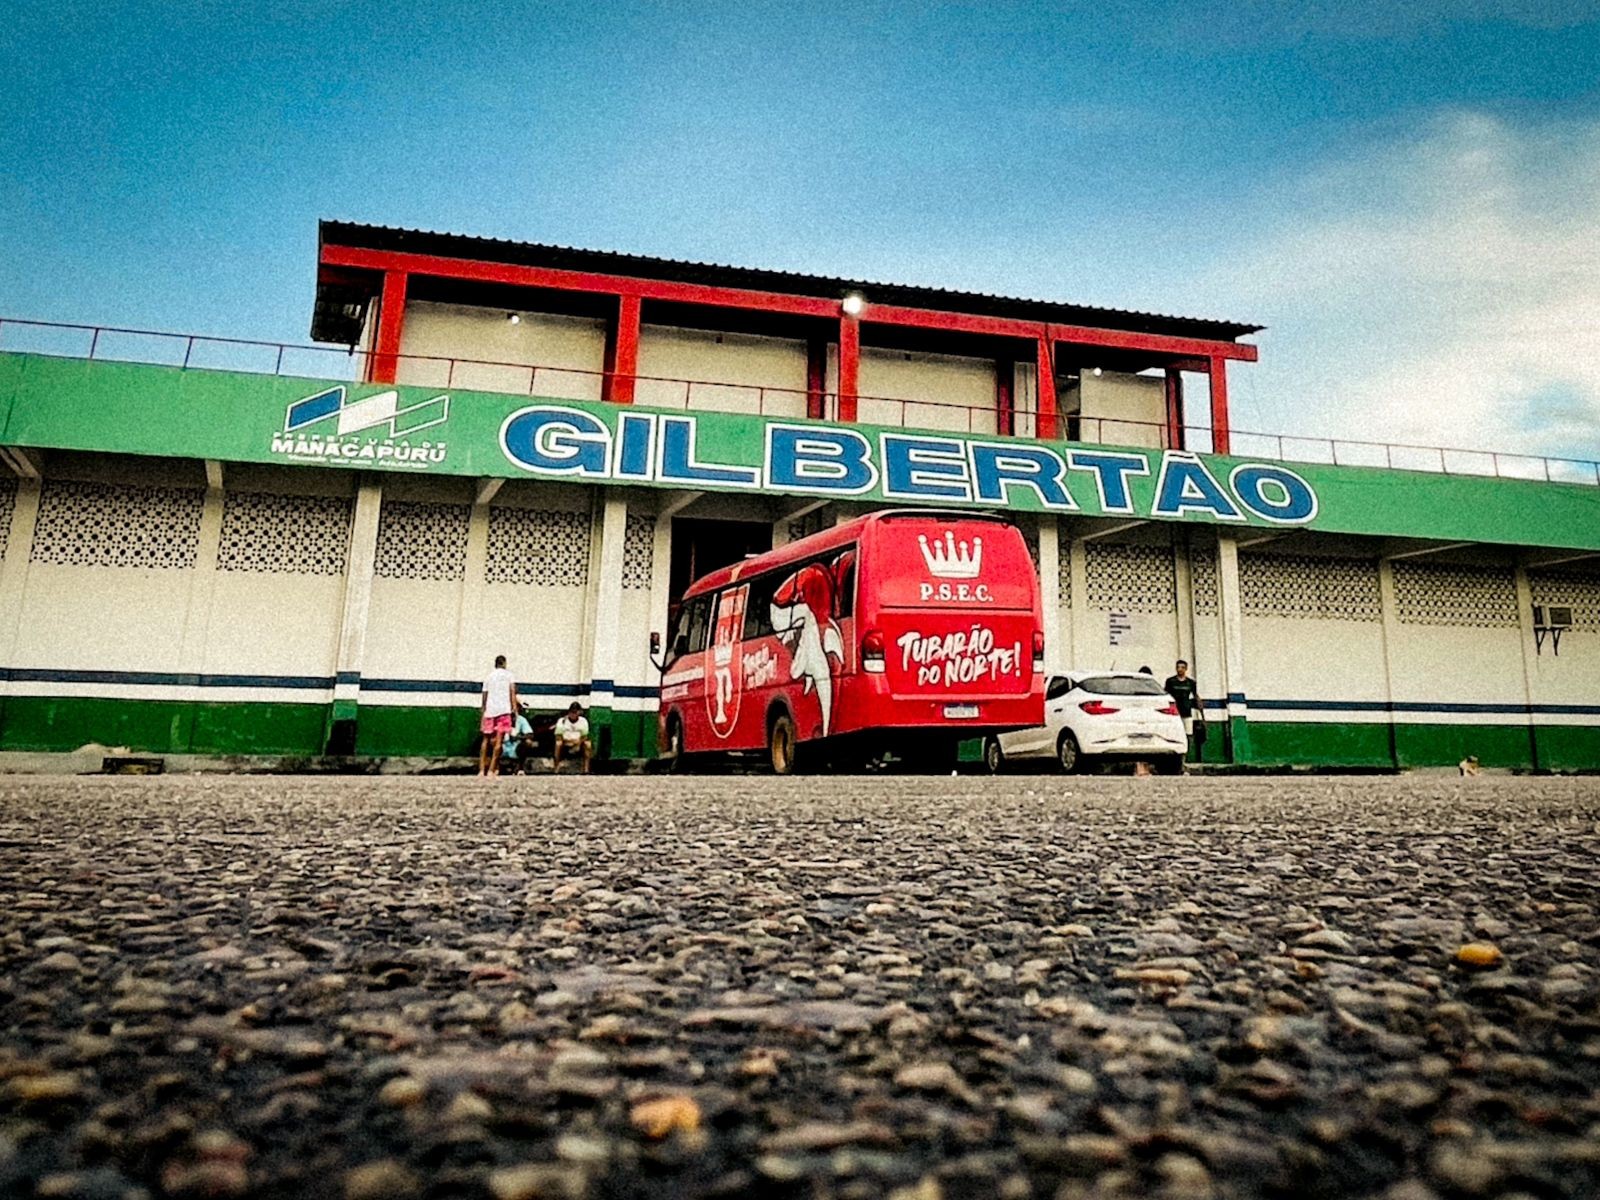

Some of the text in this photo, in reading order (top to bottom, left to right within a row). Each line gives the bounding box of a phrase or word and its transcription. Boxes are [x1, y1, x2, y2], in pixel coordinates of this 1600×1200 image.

[271, 439, 446, 462] MANACAPURU
[499, 404, 1319, 524] GILBERTÃO
[920, 583, 993, 601] P.S.E.C.
[897, 623, 993, 671] TUBARÃO
[918, 641, 1020, 687] DO NORTE!
